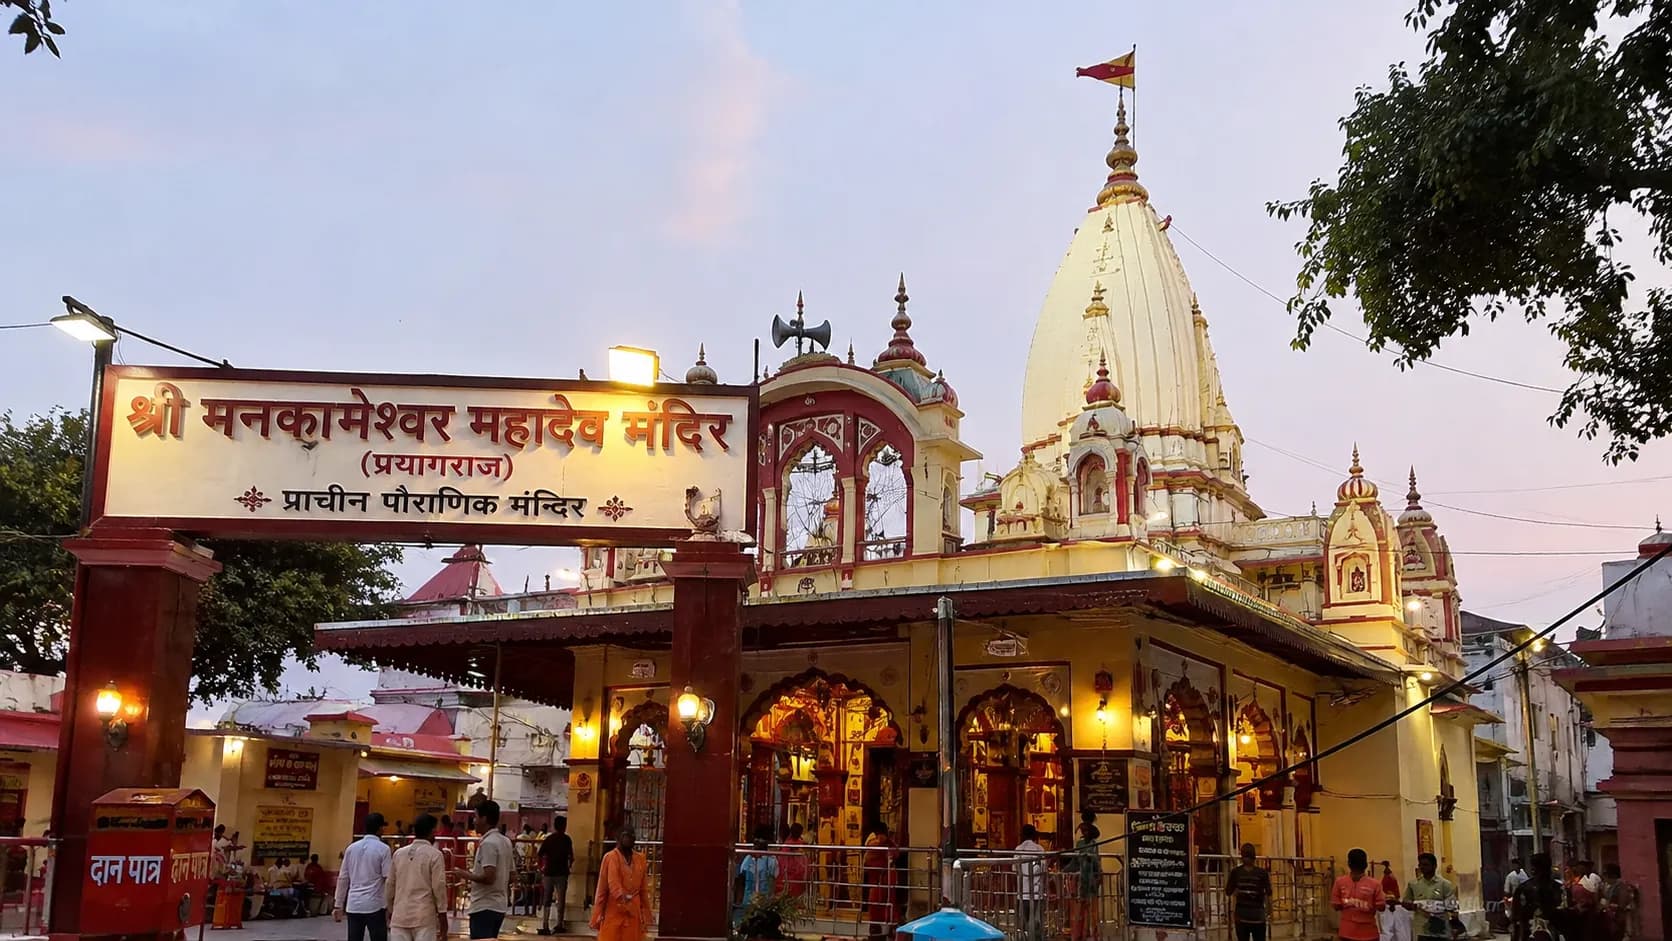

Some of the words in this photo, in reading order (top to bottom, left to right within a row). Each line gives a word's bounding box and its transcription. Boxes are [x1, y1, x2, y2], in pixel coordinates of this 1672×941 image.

[127, 382, 191, 439] श्री
[200, 387, 456, 442] मनकामेश्वर
[467, 394, 609, 449] महादेव
[622, 398, 733, 450] मंदिर
[361, 450, 513, 481] (प्रयागराज)
[282, 484, 370, 513] प्राचीन
[381, 484, 499, 516] पौराणिक
[90, 855, 126, 886] दान
[128, 855, 163, 885] पात्र
